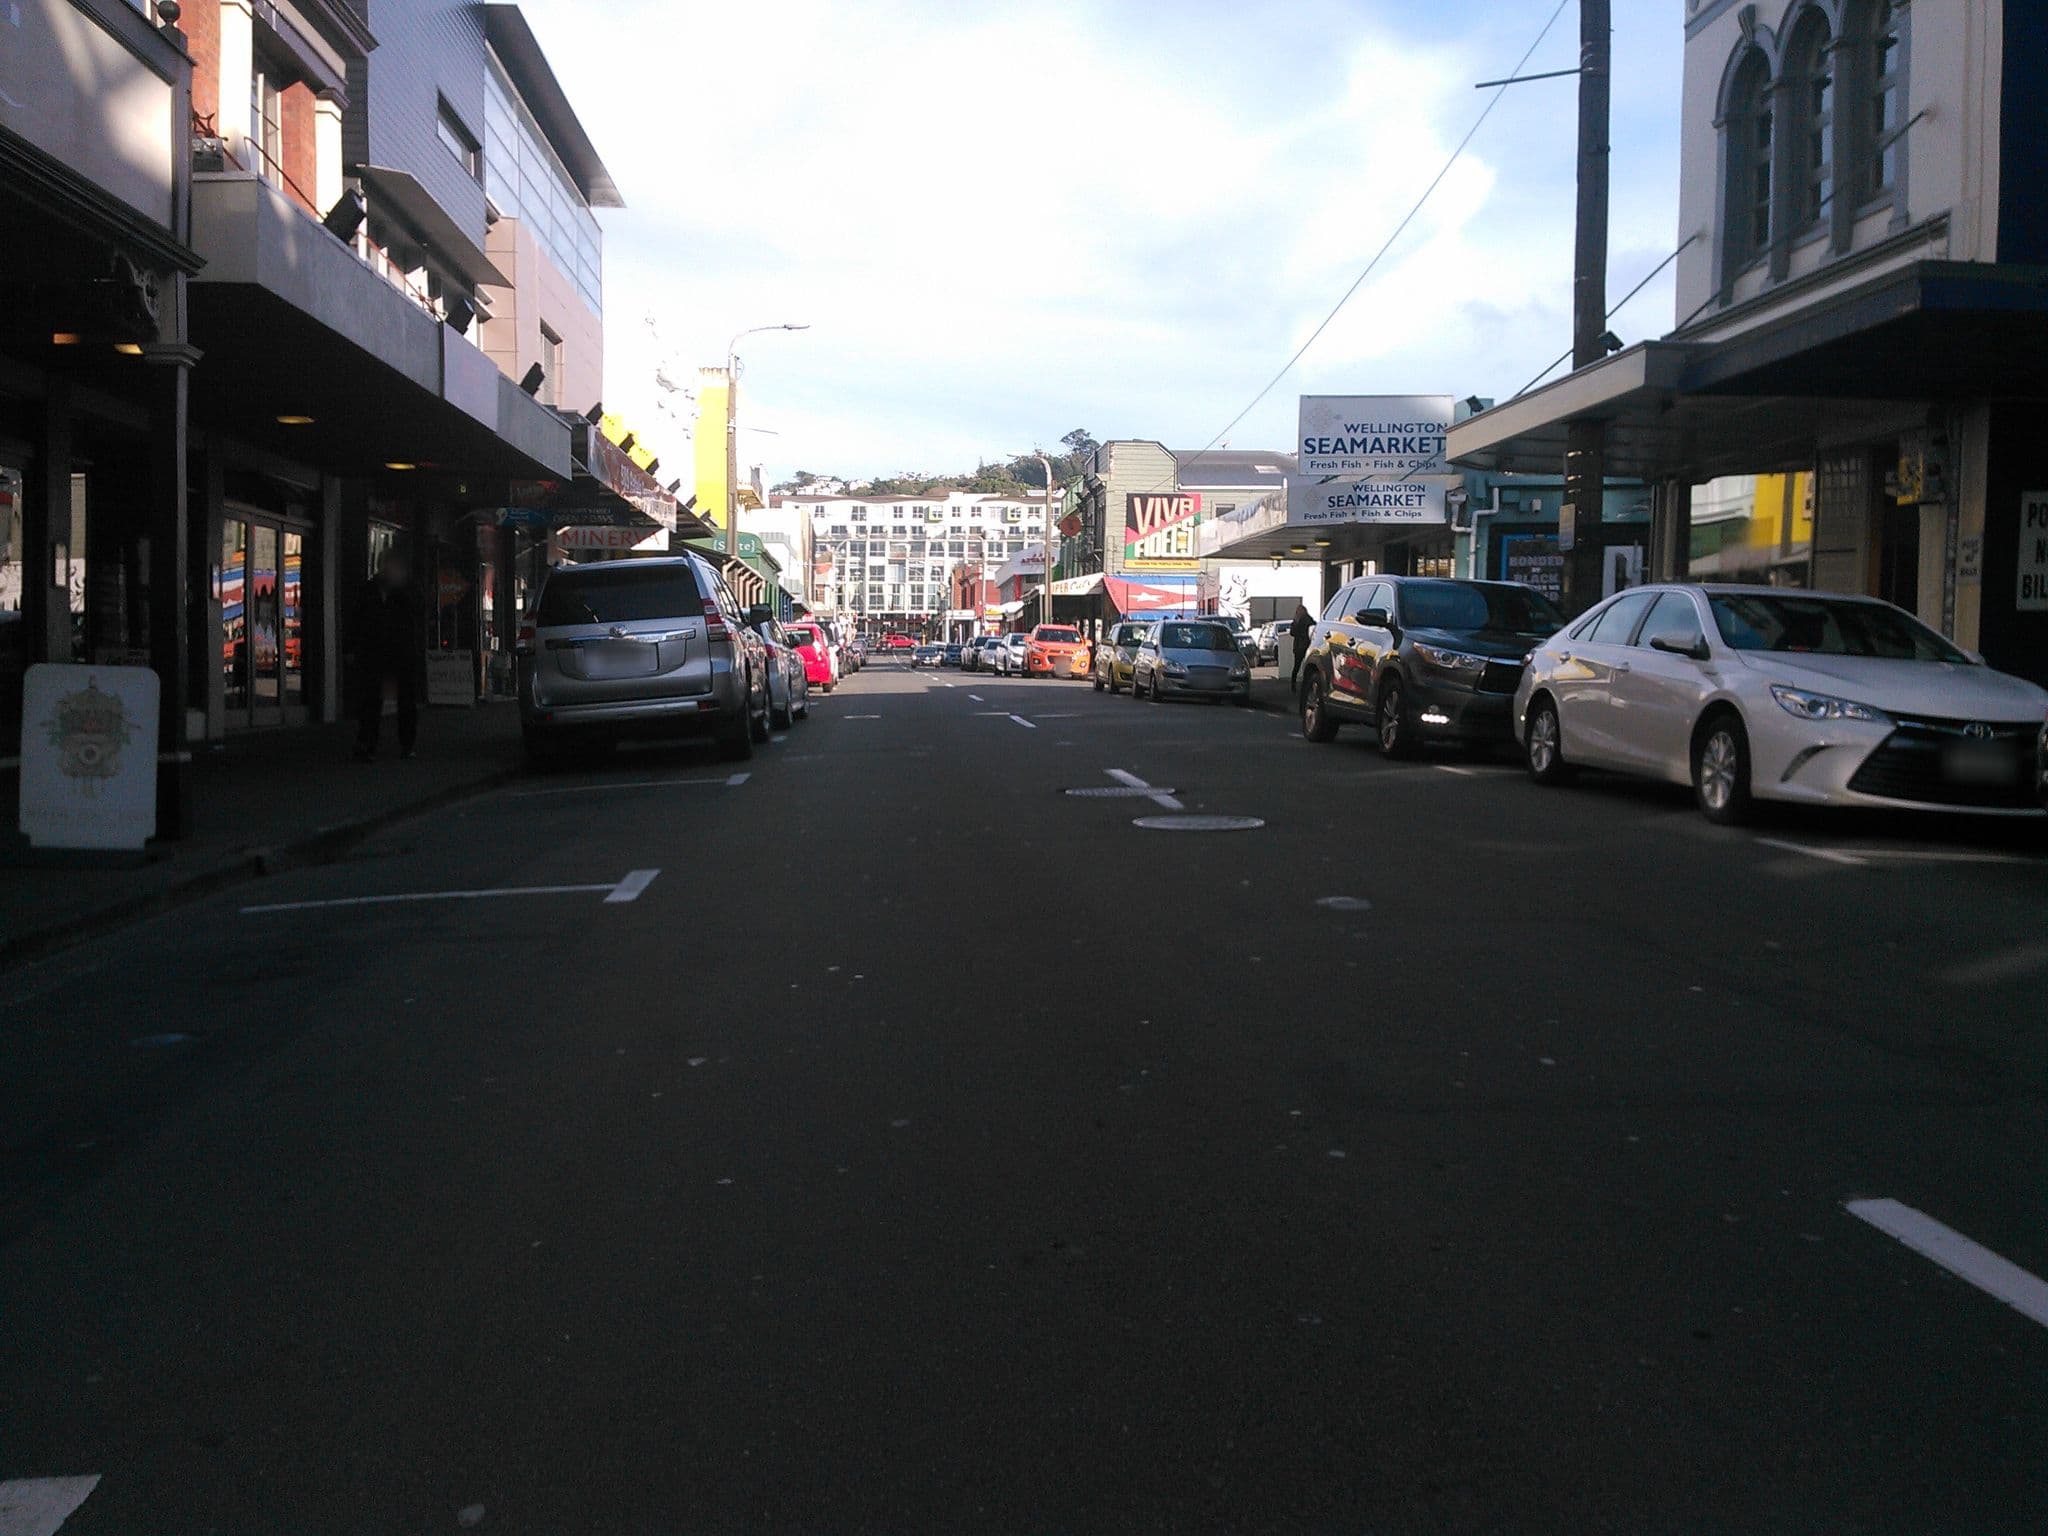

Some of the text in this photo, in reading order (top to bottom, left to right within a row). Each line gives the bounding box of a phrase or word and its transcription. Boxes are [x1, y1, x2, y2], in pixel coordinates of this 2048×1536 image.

[1344, 423, 1448, 434] WELLINGTON
[1303, 436, 1447, 455] SEAMARKET
[1310, 460, 1437, 470] Fresh Fish Fish & Chips
[1352, 484, 1426, 493] WELLINGTON
[1327, 494, 1426, 508] SEAMARKET
[1133, 496, 1195, 536] VIVA
[1303, 512, 1328, 520] Fresh
[1330, 511, 1348, 519] Fish
[1361, 510, 1381, 518] Fish
[1394, 509, 1422, 519] Chips
[561, 528, 661, 547] MINERVA
